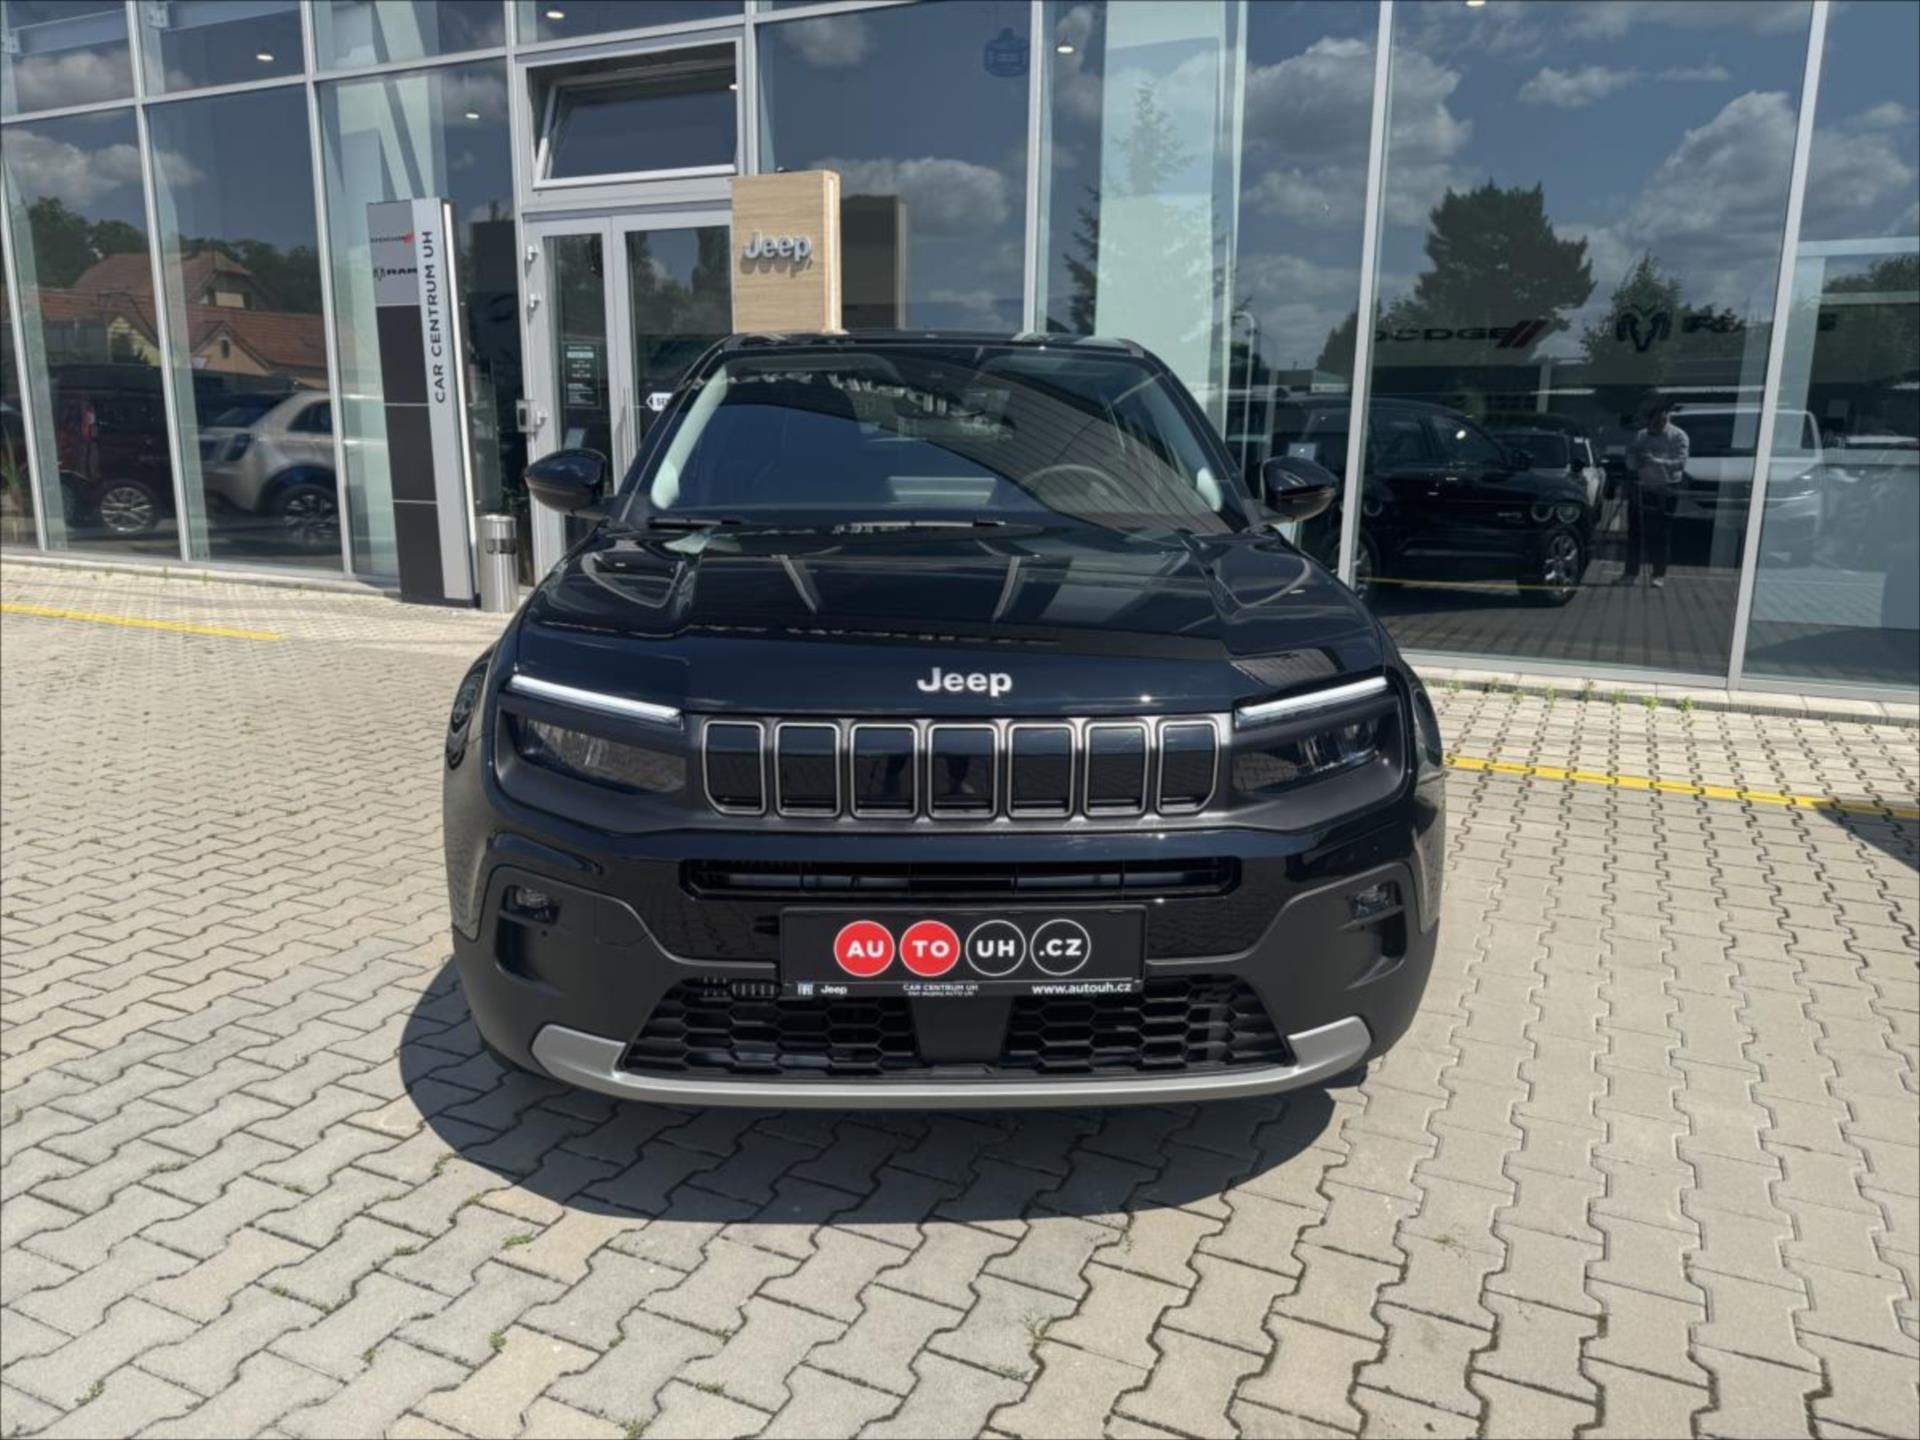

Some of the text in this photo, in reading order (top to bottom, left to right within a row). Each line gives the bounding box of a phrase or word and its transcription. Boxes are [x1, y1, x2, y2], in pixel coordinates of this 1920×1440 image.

[743, 230, 812, 262] Jeep
[421, 231, 446, 404] CAR CENTRUM UH
[917, 667, 1012, 697] Jeep
[820, 985, 848, 996] Jeep
[1032, 982, 1132, 996] www.autouh.cz
